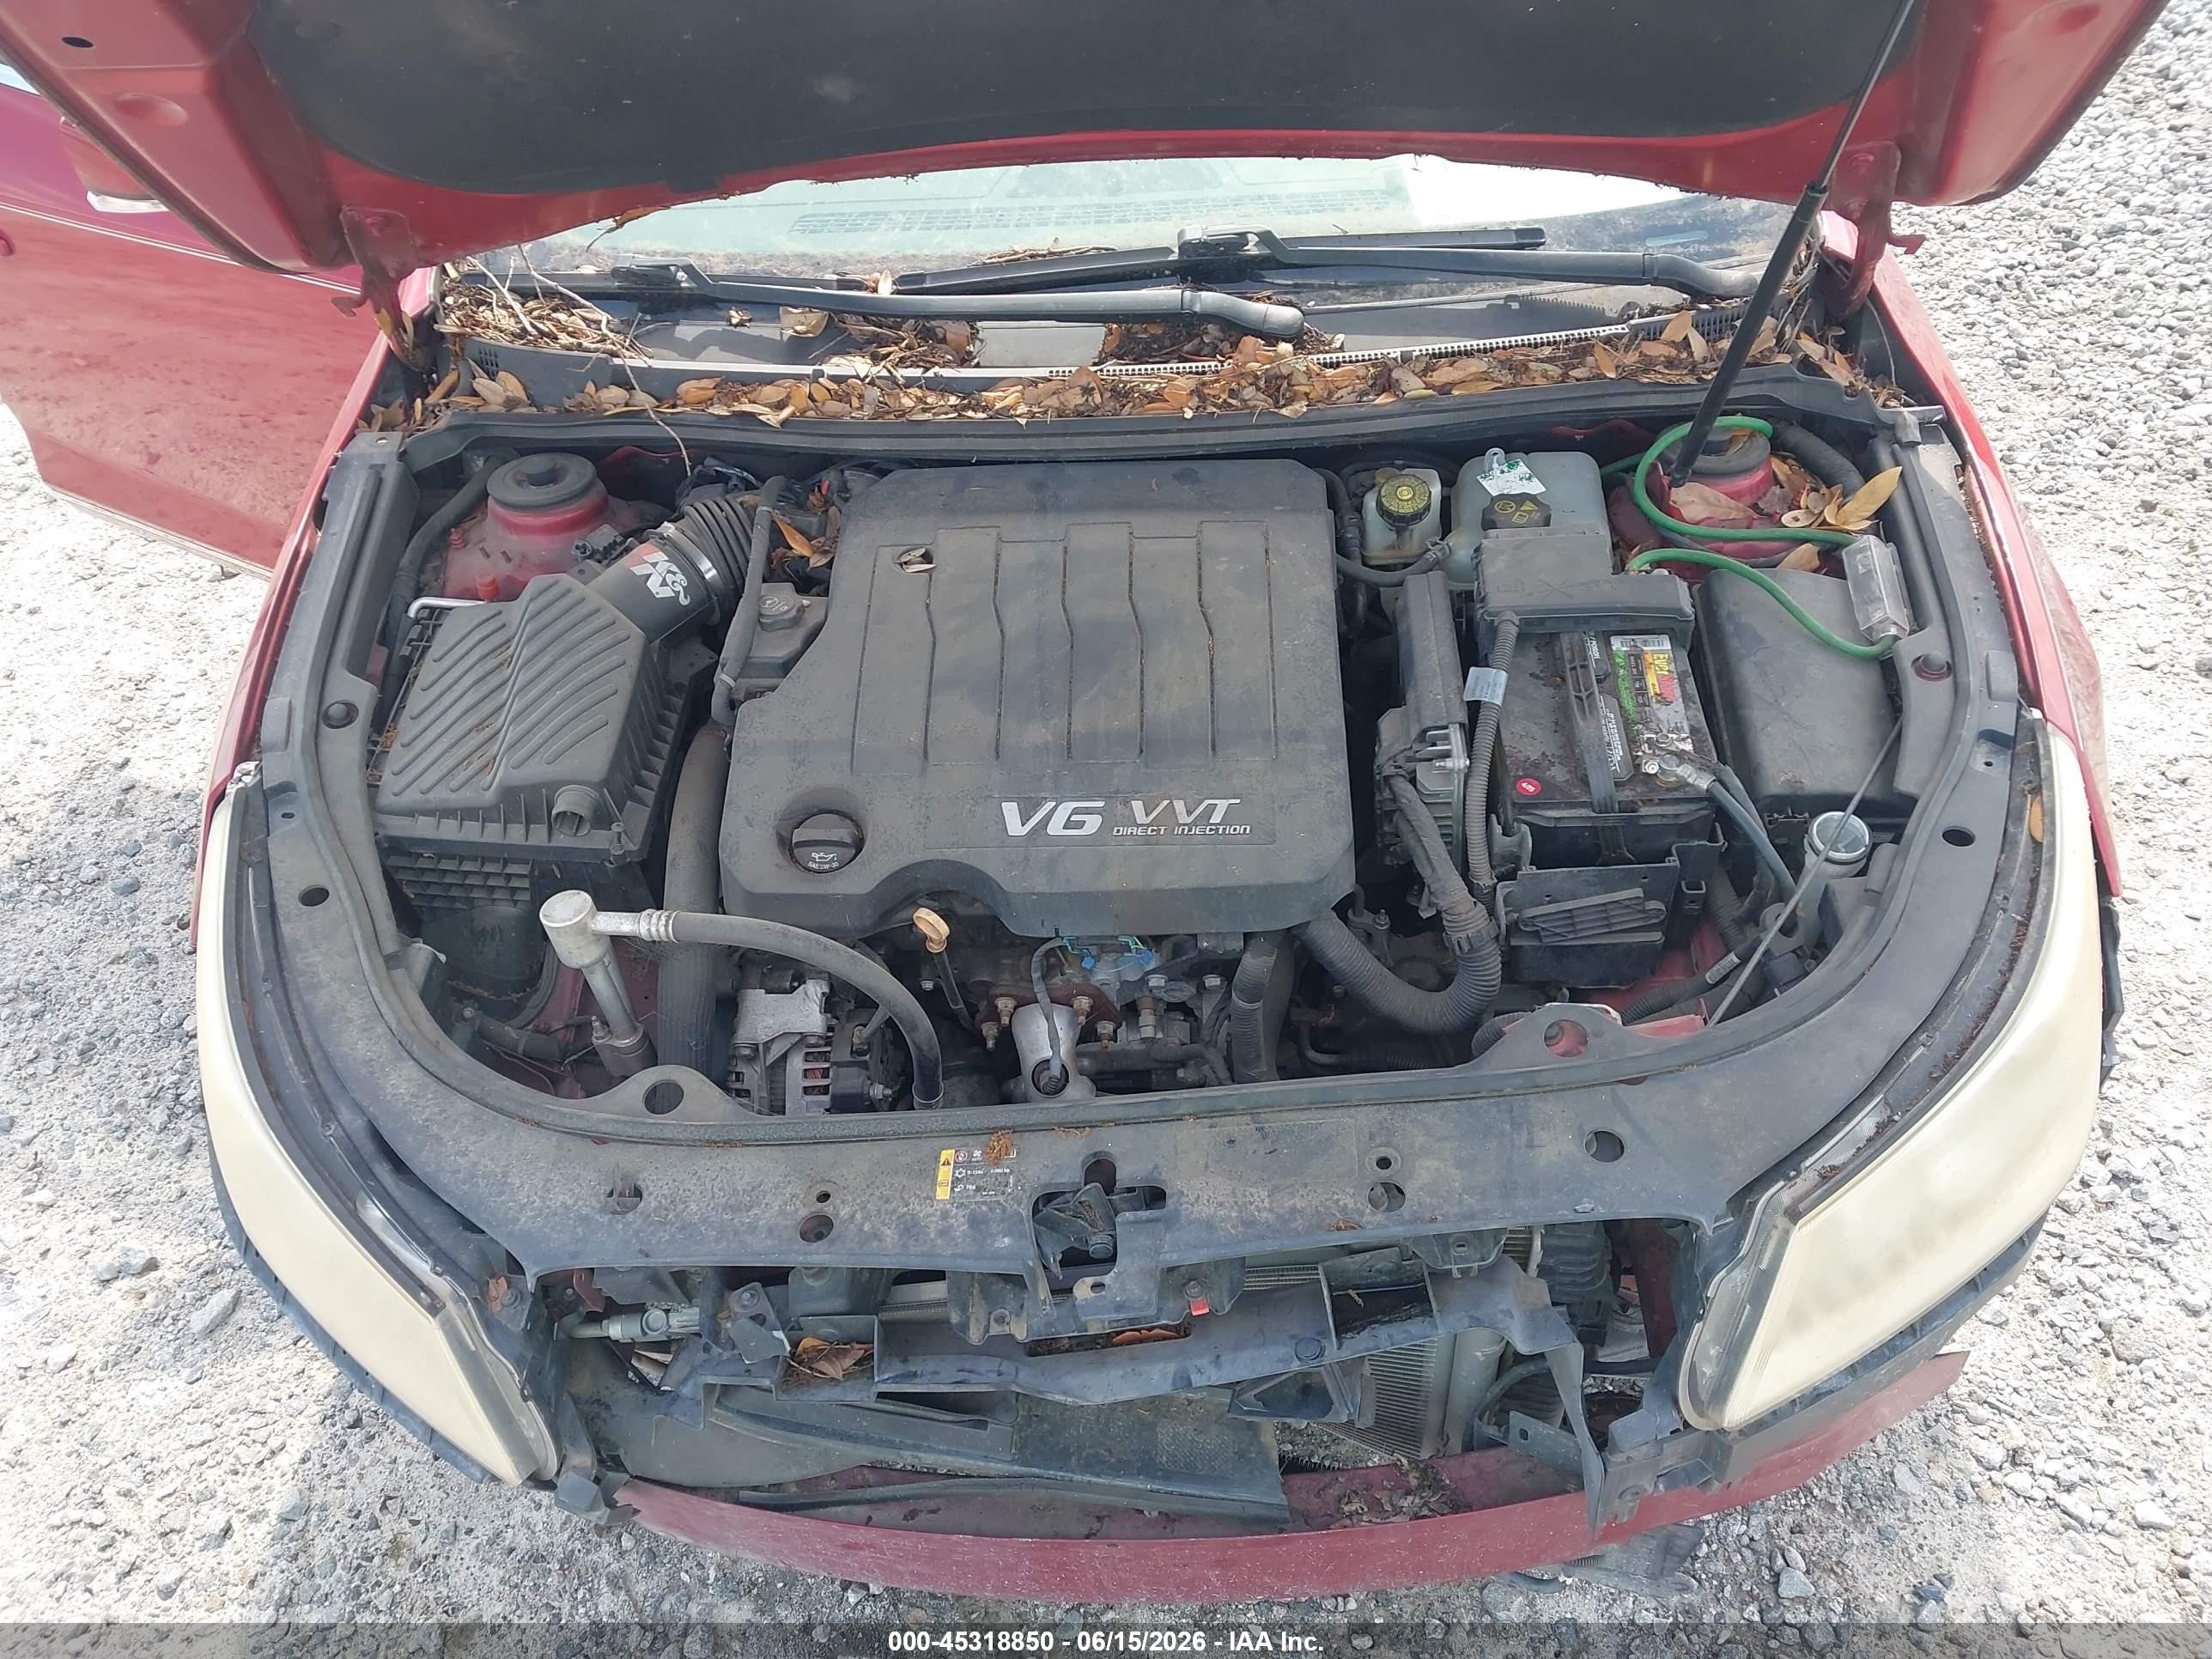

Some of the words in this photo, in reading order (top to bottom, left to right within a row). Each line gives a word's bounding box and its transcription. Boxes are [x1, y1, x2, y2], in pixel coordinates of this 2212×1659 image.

[1000, 801, 1106, 836] V6
[1130, 799, 1242, 825] VVT
[1112, 826, 1168, 836] DIRECT
[1174, 824, 1251, 836] INJECTION
